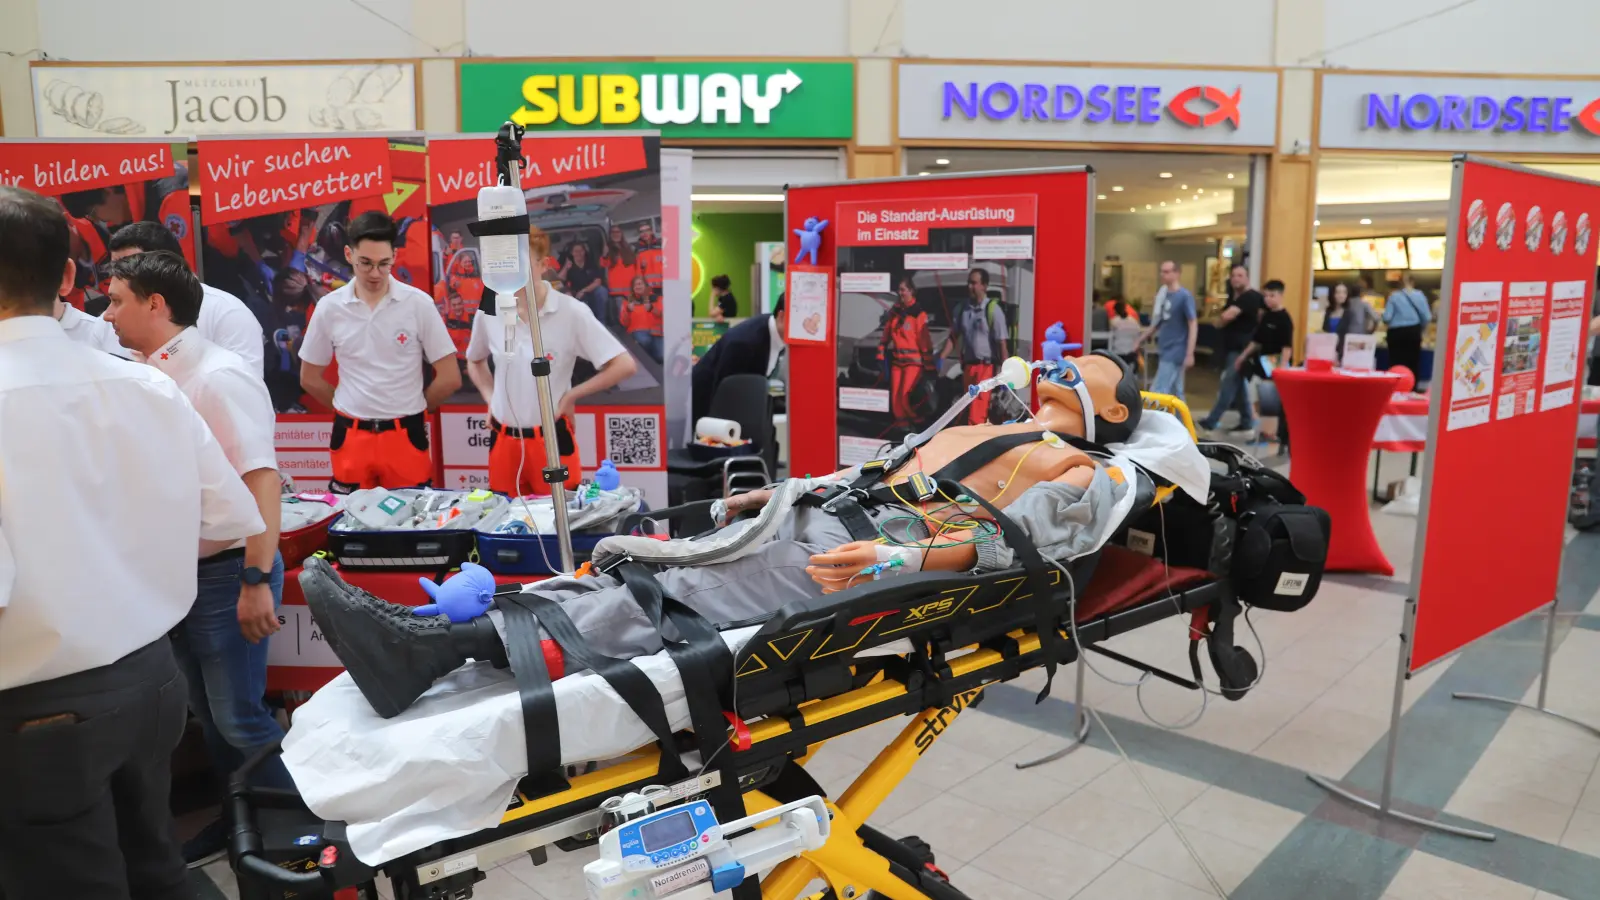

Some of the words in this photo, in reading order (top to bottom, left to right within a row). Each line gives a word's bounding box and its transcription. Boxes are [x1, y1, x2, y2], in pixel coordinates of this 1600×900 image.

[164, 76, 287, 134] Jacob
[511, 70, 803, 126] SUBWAY
[943, 81, 1161, 124] NORDSEE
[1366, 92, 1573, 132] NORDSEE
[34, 158, 109, 187] bilden
[119, 148, 165, 175] aus!
[207, 154, 254, 182] Wir
[265, 143, 351, 173] suchen
[438, 161, 491, 193] Weil
[552, 143, 605, 174] will!
[215, 165, 383, 212] Lebensretter!
[857, 210, 877, 223] Die
[880, 207, 1015, 223] Standard-Ausrüstung
[857, 229, 871, 241] im
[875, 228, 919, 241] Einsatz
[905, 597, 954, 620] XPS
[654, 862, 706, 888] Noradrenalin
